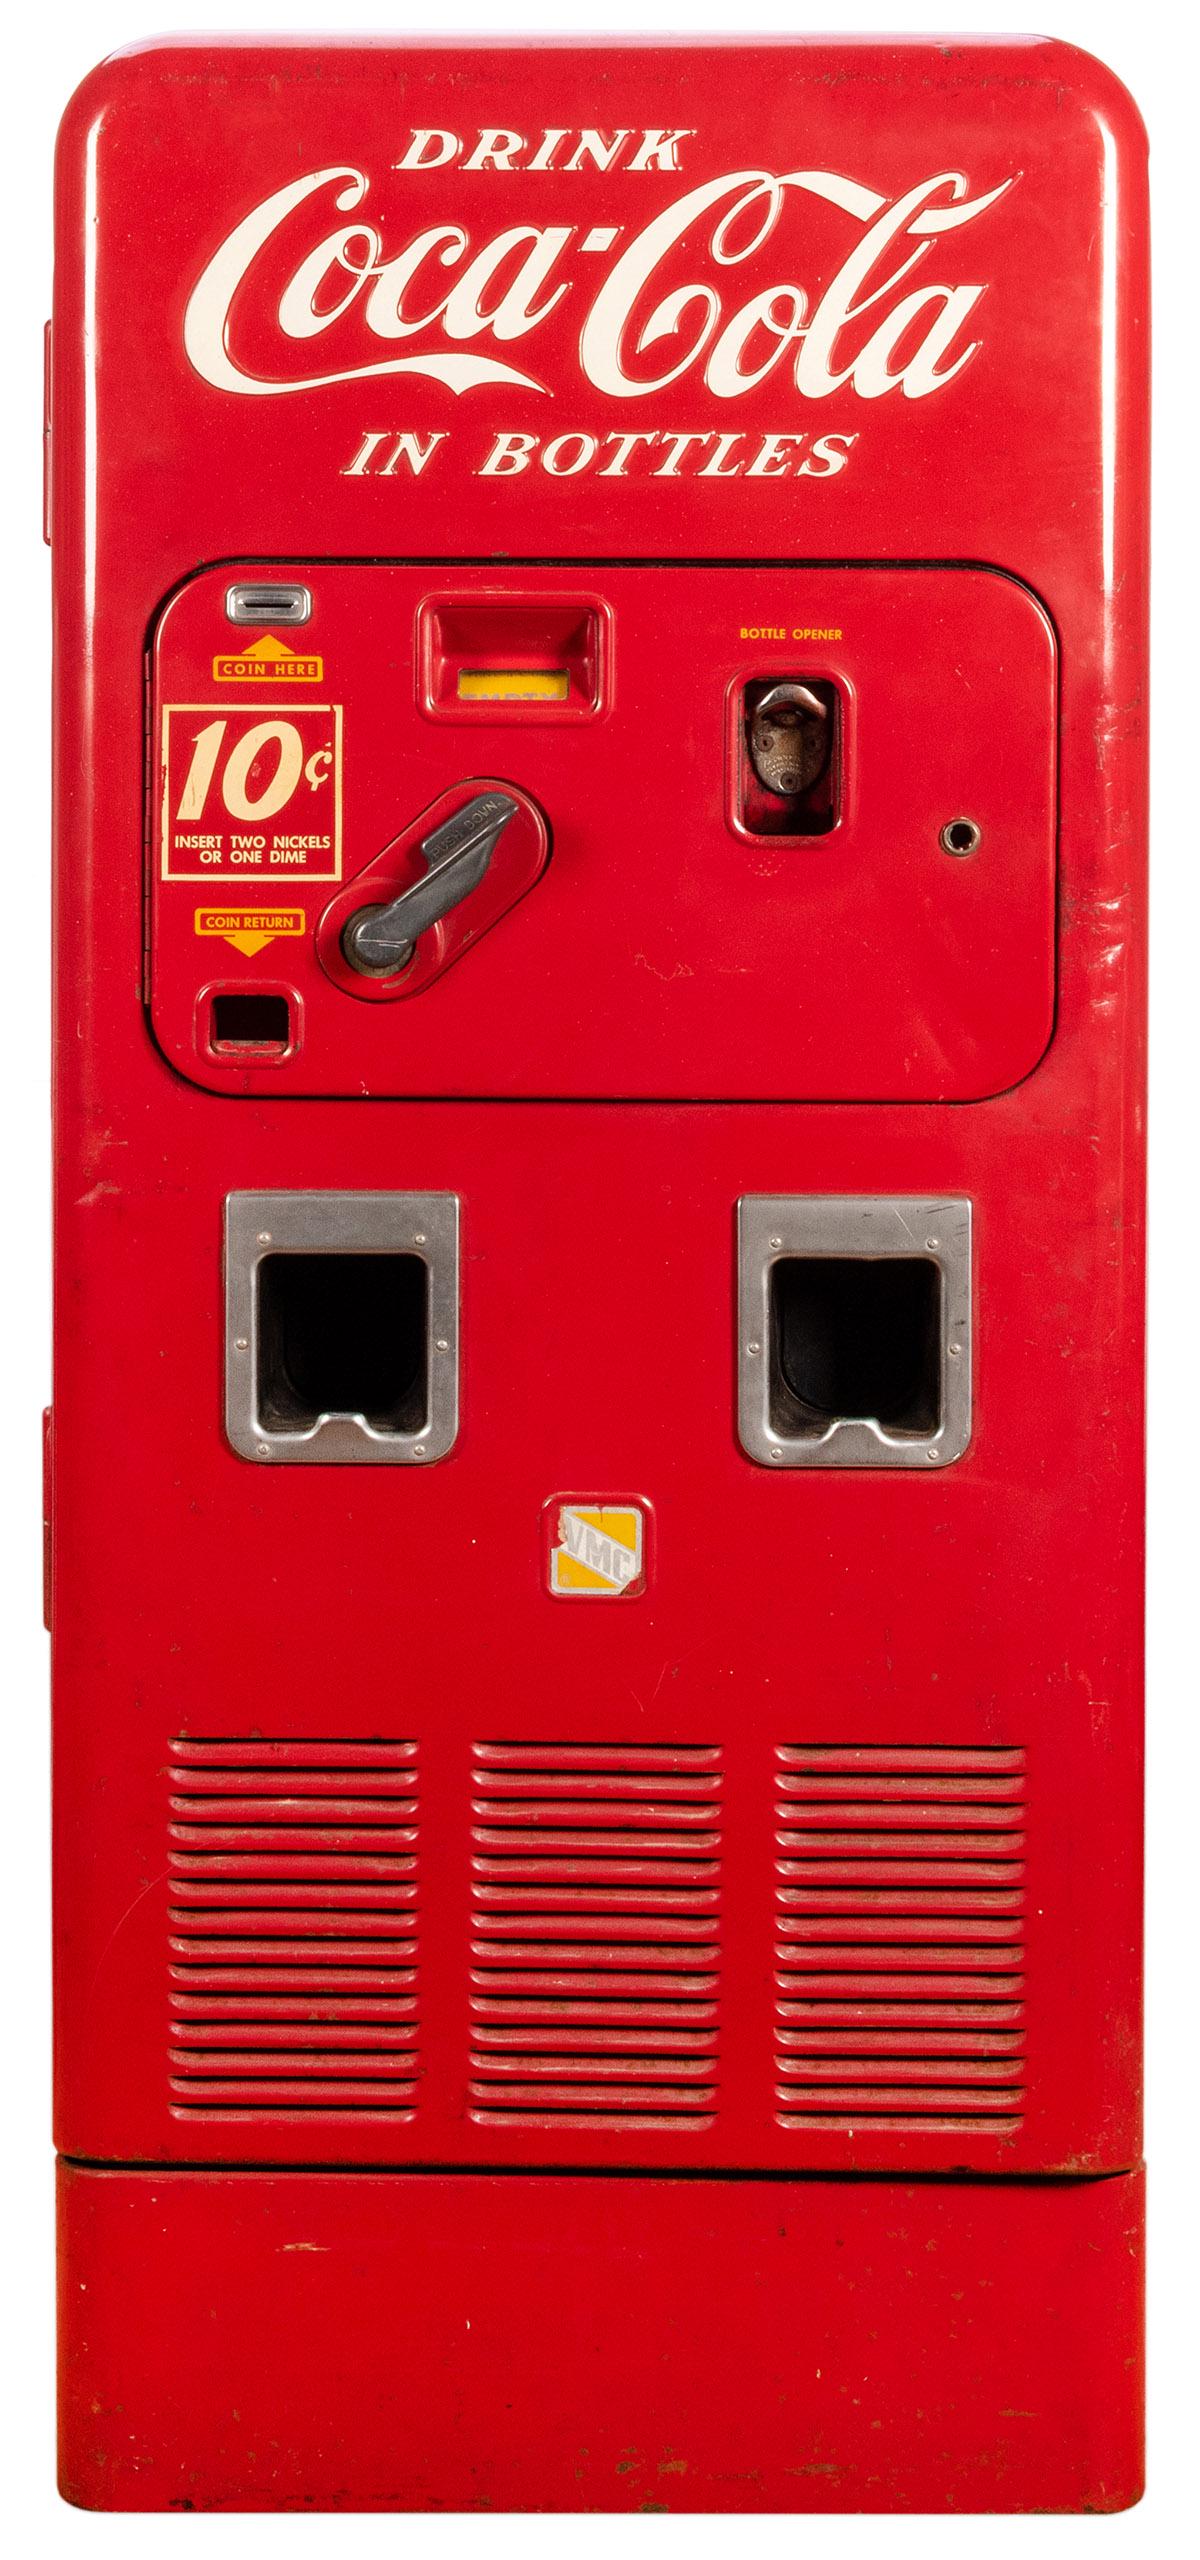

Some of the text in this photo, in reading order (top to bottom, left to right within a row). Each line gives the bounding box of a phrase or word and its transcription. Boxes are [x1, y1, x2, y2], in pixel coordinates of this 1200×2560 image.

[393, 129, 697, 172] DRINK
[185, 166, 1025, 400] Coca-Cola
[341, 432, 859, 478] IN BOTTLES
[740, 628, 843, 641] BOTTLE OPENER
[222, 663, 316, 676] COIN HERE
[464, 800, 499, 830] DOWN
[175, 836, 331, 849] INSERT TWO NICKELS
[199, 850, 307, 864] OR ONE DIME
[205, 916, 294, 929] COIN RETURN
